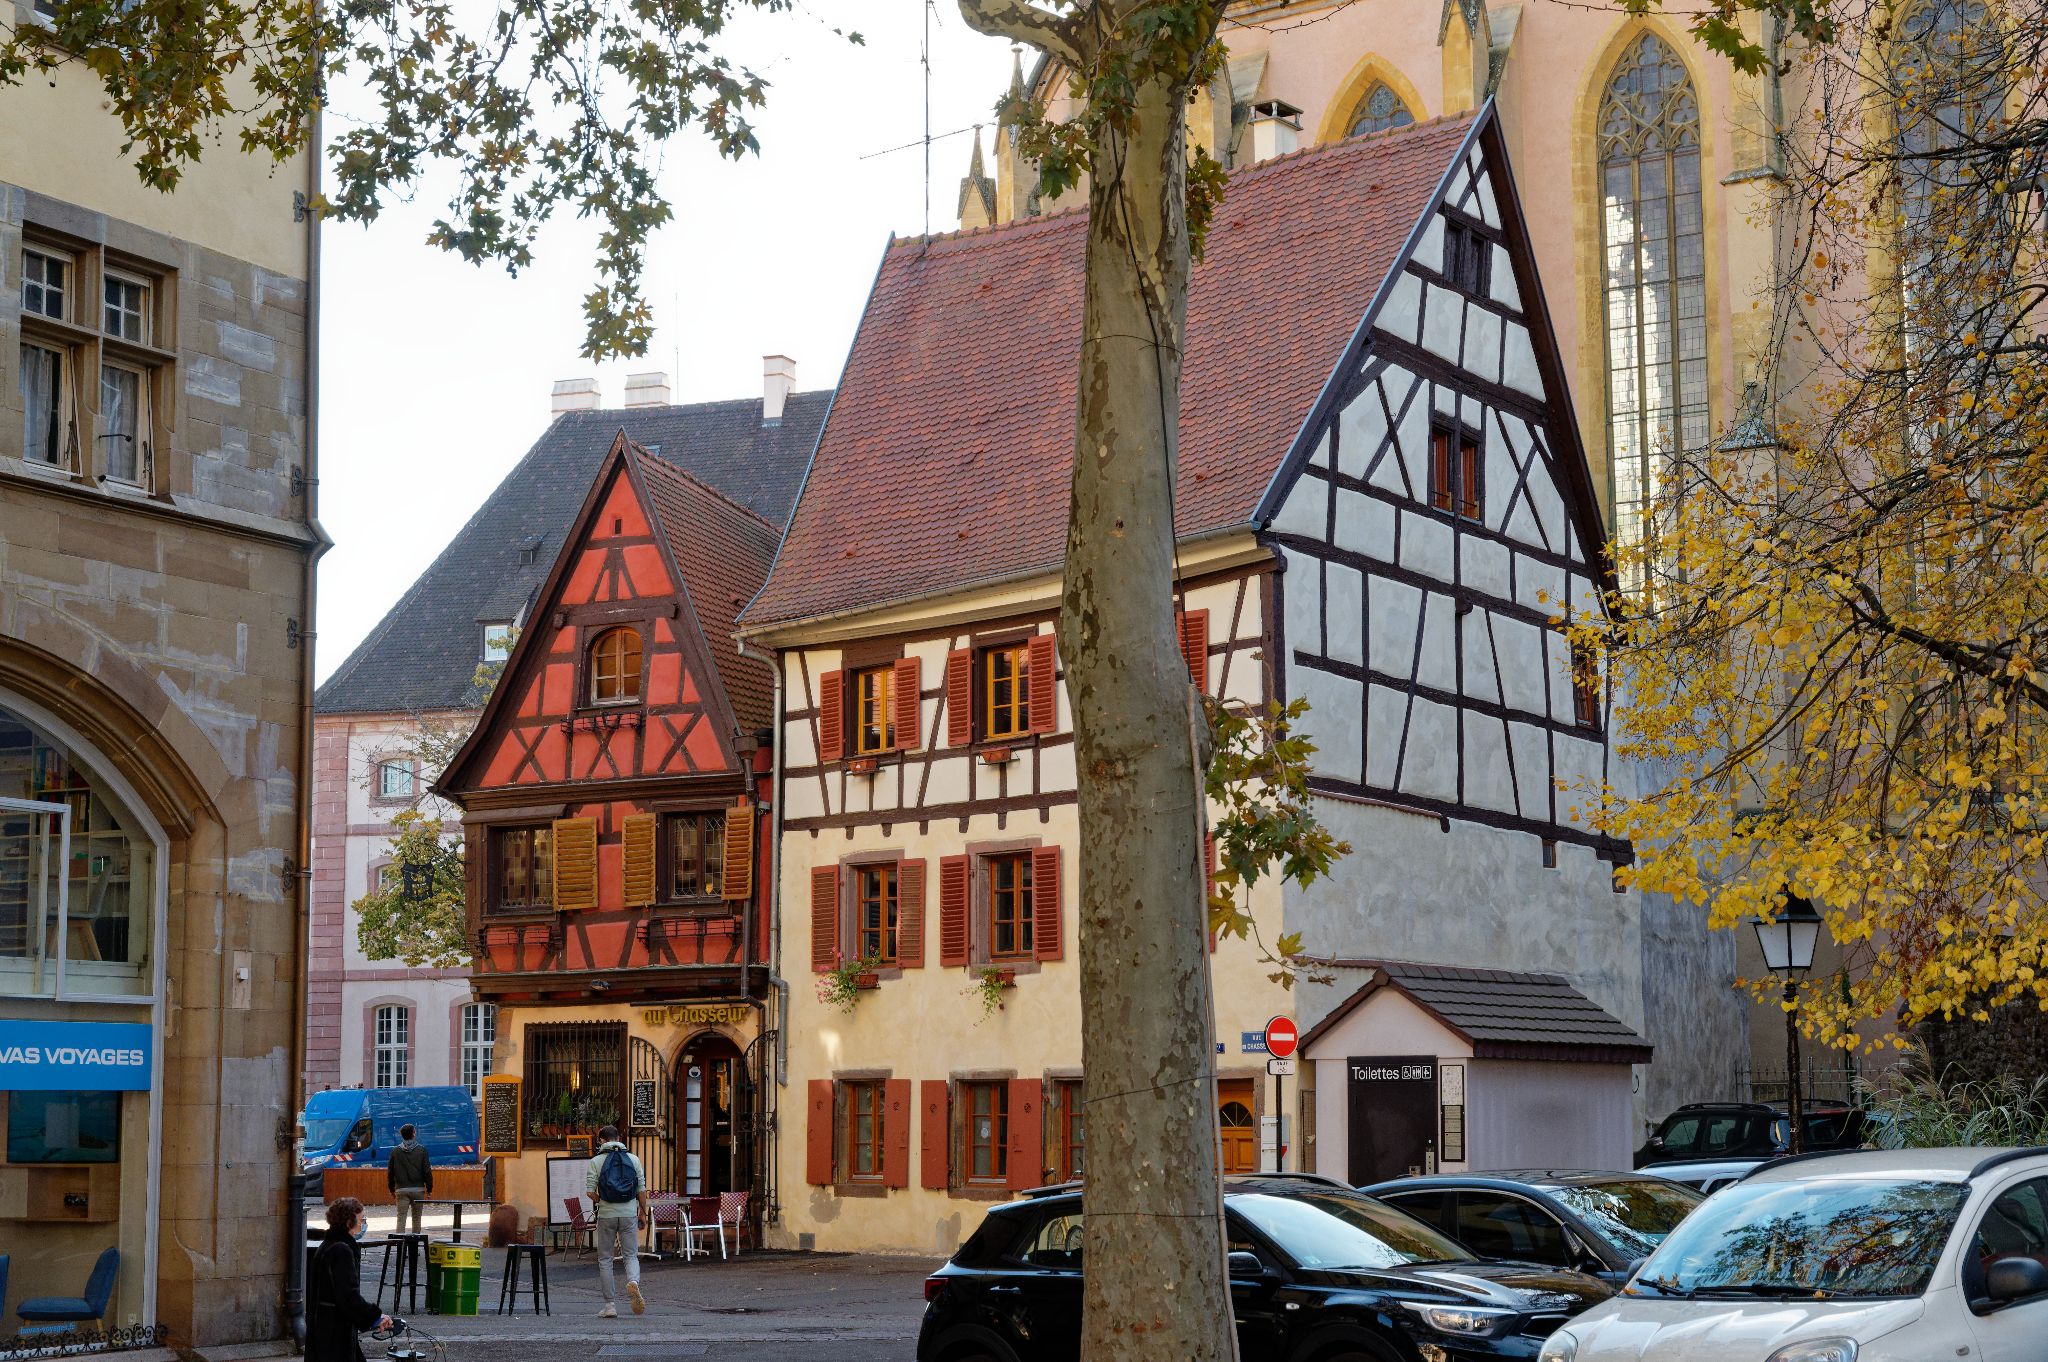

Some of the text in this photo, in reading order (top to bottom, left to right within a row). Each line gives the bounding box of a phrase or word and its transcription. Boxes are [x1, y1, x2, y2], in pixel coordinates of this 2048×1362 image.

[642, 1006, 746, 1024] au Chasseur
[44, 1047, 144, 1066] VOYAGES
[1351, 1066, 1400, 1080] Toilettes
